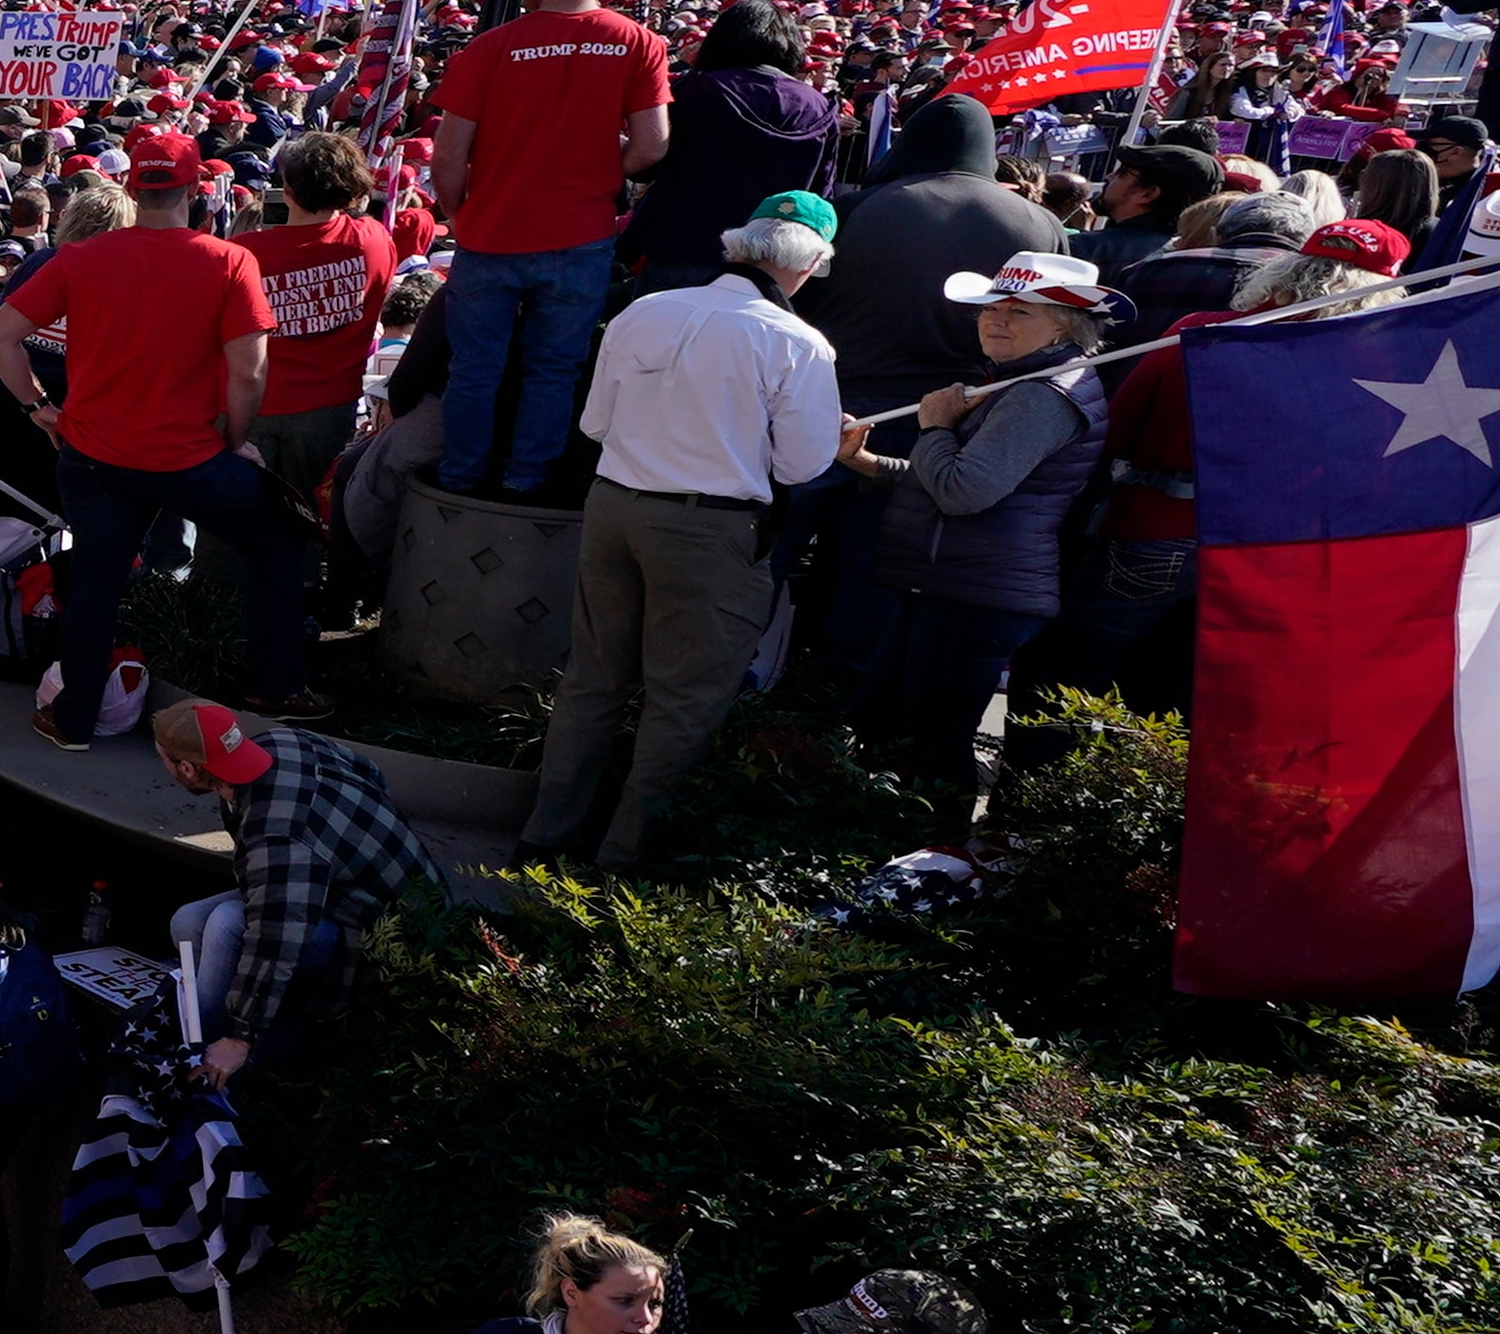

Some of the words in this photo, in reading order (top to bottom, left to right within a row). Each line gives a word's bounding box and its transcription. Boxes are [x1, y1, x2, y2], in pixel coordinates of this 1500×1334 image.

[510, 45, 576, 63] TRUMP
[579, 41, 628, 57] 2020
[60, 64, 114, 99] BACK
[1320, 225, 1380, 253] TRUMP
[285, 255, 368, 286] FREEDOM
[266, 283, 333, 310] OESN'T
[335, 273, 368, 297] END
[271, 320, 304, 337] AR
[307, 310, 364, 335] BEGINS
[274, 304, 321, 327] HERE
